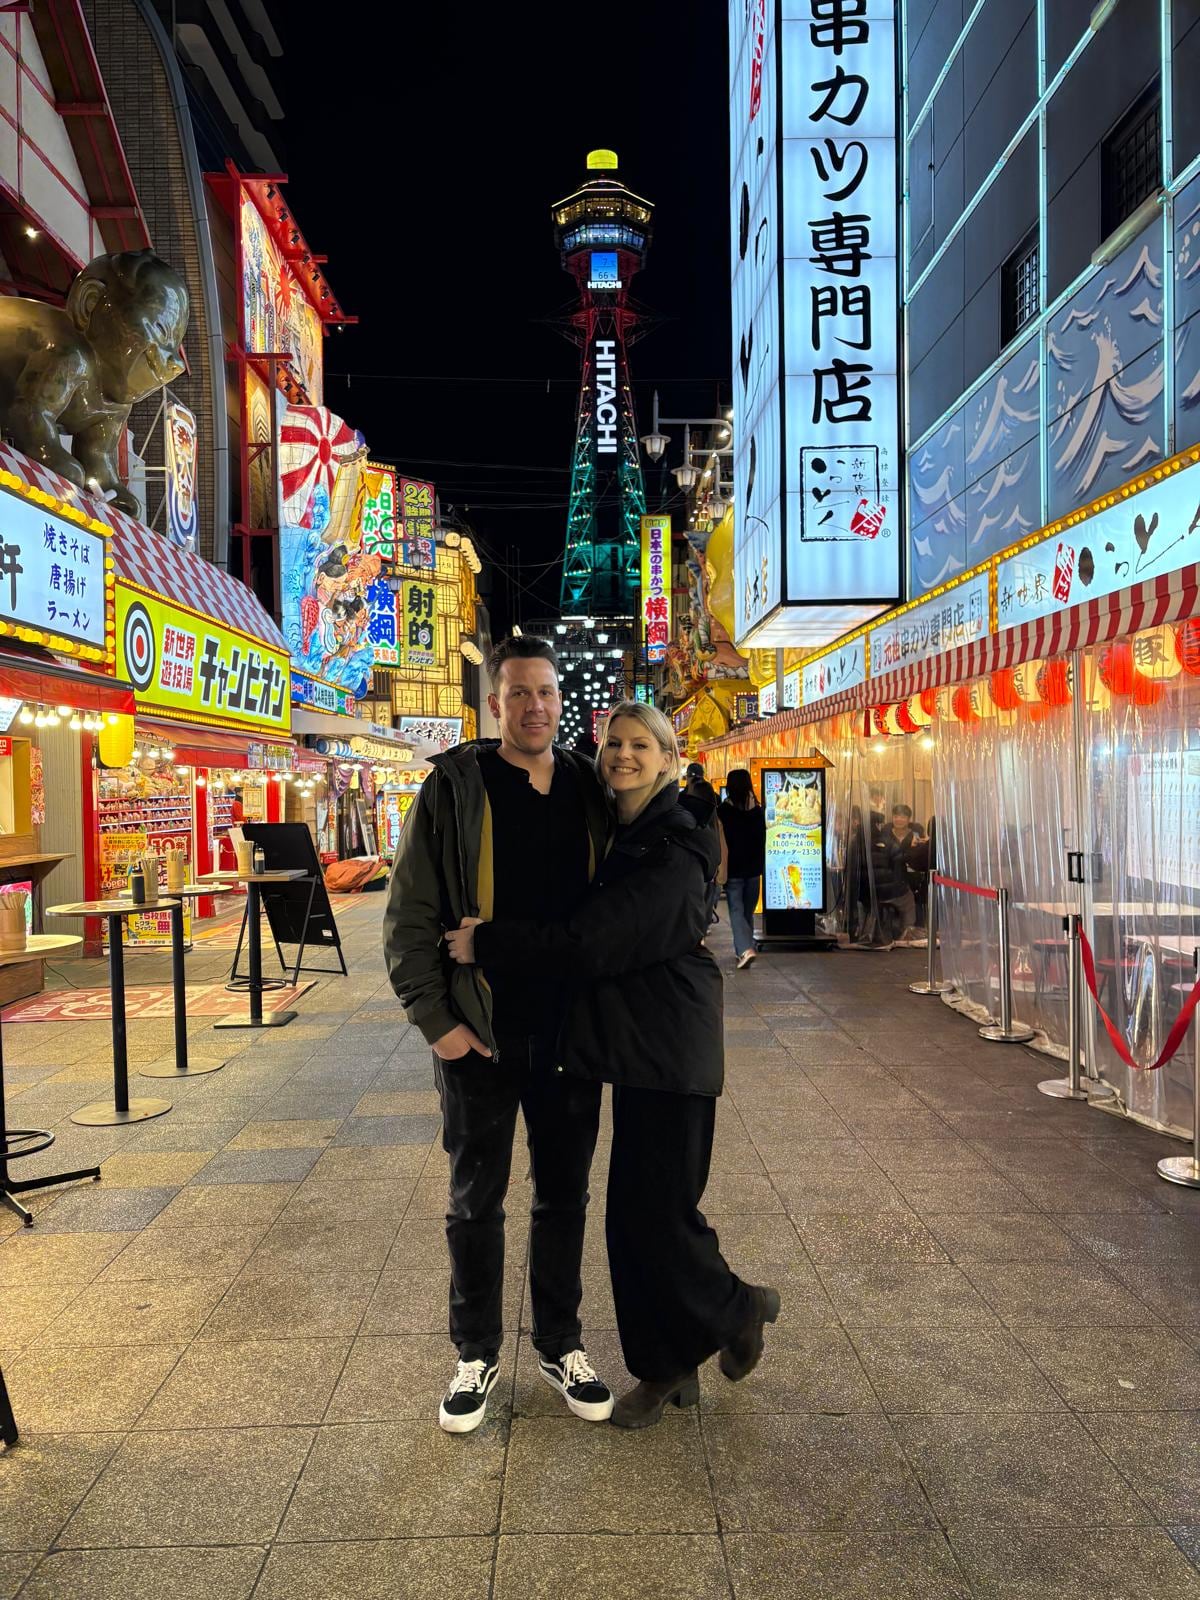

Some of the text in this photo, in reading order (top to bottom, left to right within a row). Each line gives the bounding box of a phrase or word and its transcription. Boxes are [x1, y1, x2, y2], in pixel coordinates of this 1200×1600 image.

[807, 0, 873, 424] 串カツ専門店
[587, 280, 623, 289] HITACHI
[596, 340, 618, 454] HITACHI
[404, 484, 433, 507] 24
[43, 521, 90, 566] 焼きそば
[650, 528, 663, 596] 日本一の串かつ
[49, 564, 87, 599] 唐揚げ
[47, 600, 91, 632] ラーメン
[366, 577, 397, 648] 横綱
[408, 584, 435, 651] 射的
[645, 597, 669, 645] 横綱
[883, 602, 966, 668] 元祖串カツ専門店
[162, 626, 196, 662] 新世界
[160, 658, 194, 693] 遊技場
[199, 635, 287, 721] チャンピオン
[106, 877, 128, 888] OPEN
